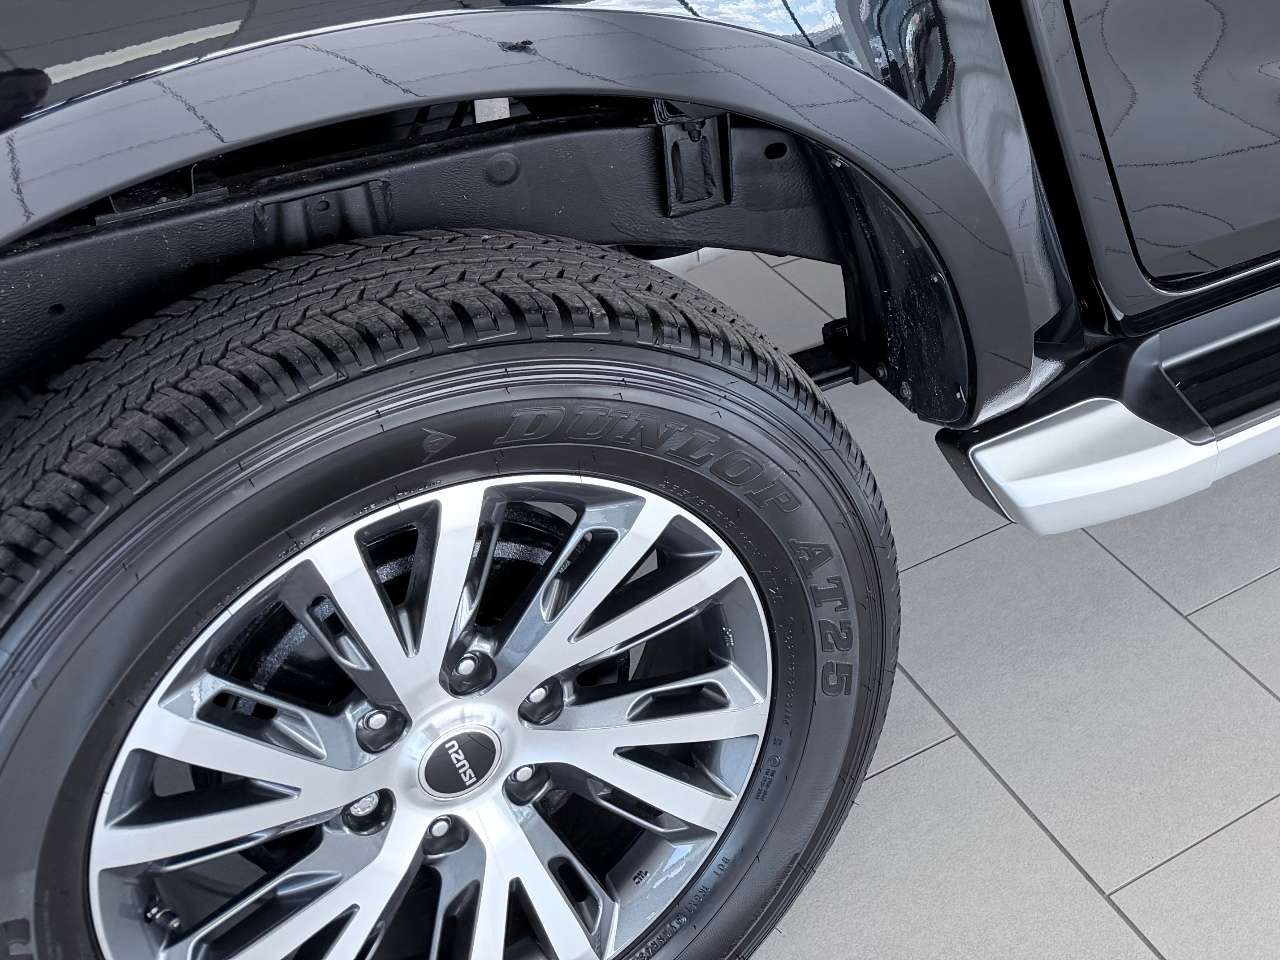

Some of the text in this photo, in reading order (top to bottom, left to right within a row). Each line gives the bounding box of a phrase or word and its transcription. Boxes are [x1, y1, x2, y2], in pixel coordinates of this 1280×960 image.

[494, 405, 803, 514] DUNLOP
[786, 538, 854, 698] AT25
[444, 739, 478, 787] ISUZU
